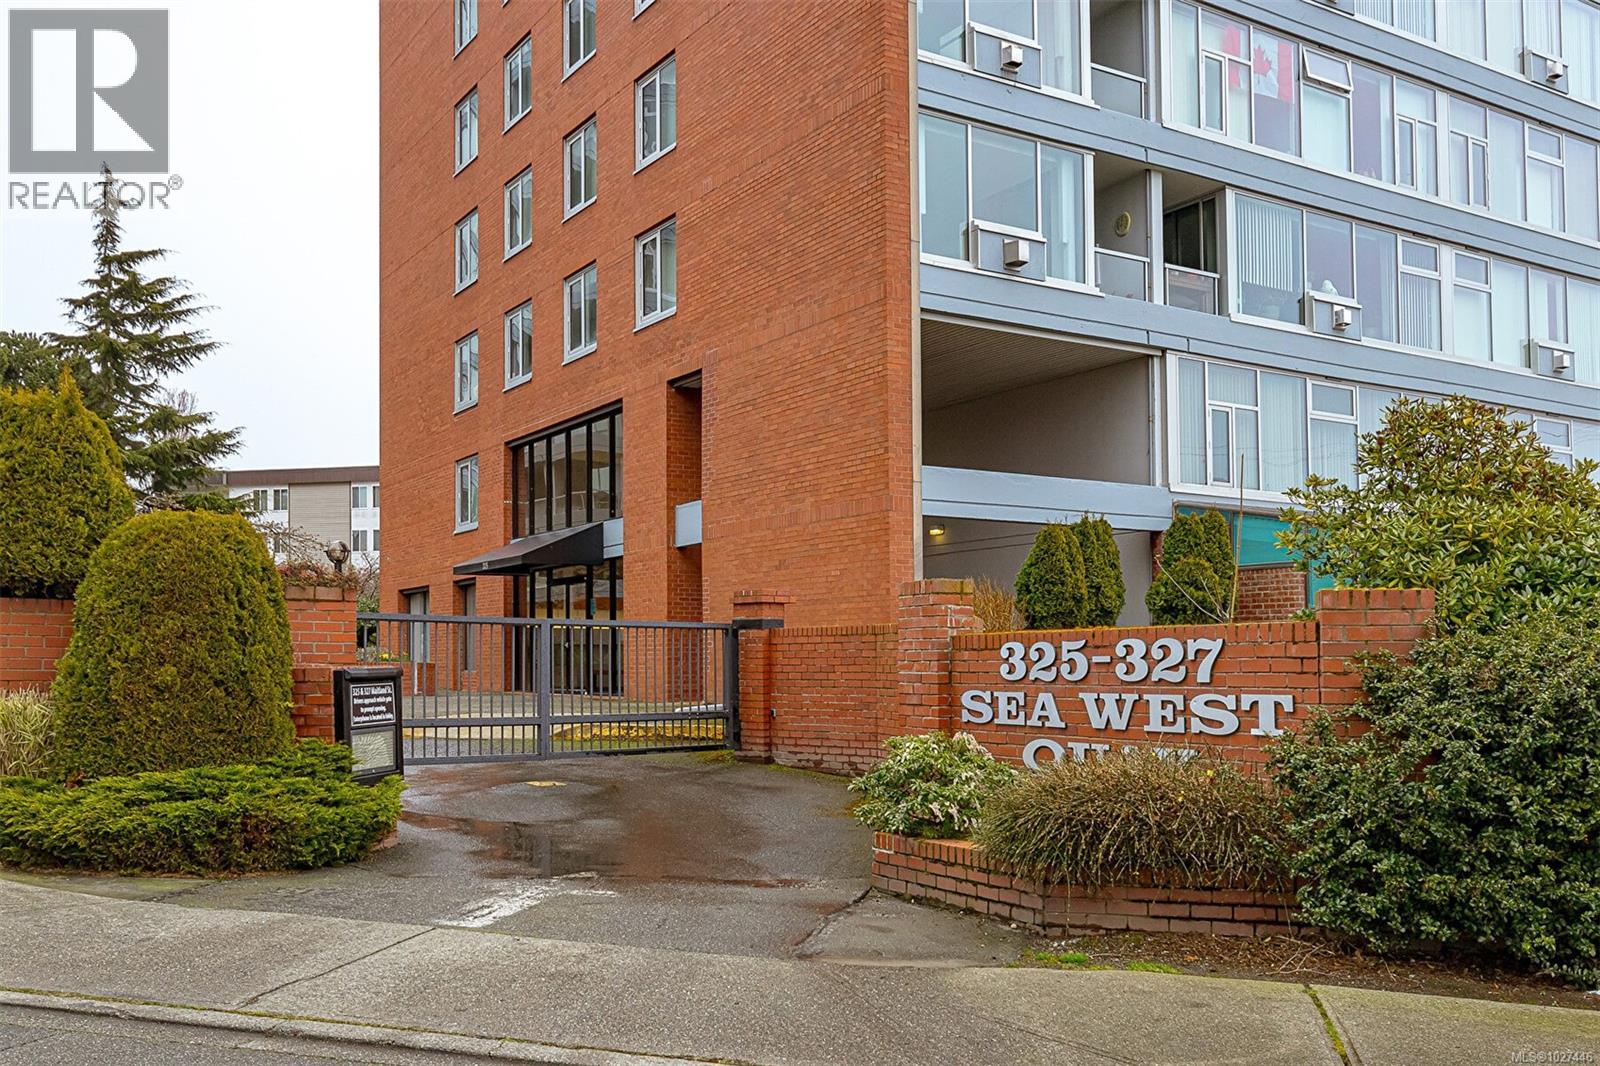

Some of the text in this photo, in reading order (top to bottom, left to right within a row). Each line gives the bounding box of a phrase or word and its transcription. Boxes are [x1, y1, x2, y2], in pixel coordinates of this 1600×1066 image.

[1000, 637, 1224, 683] 325-327
[960, 690, 1295, 737] SEA WEST
